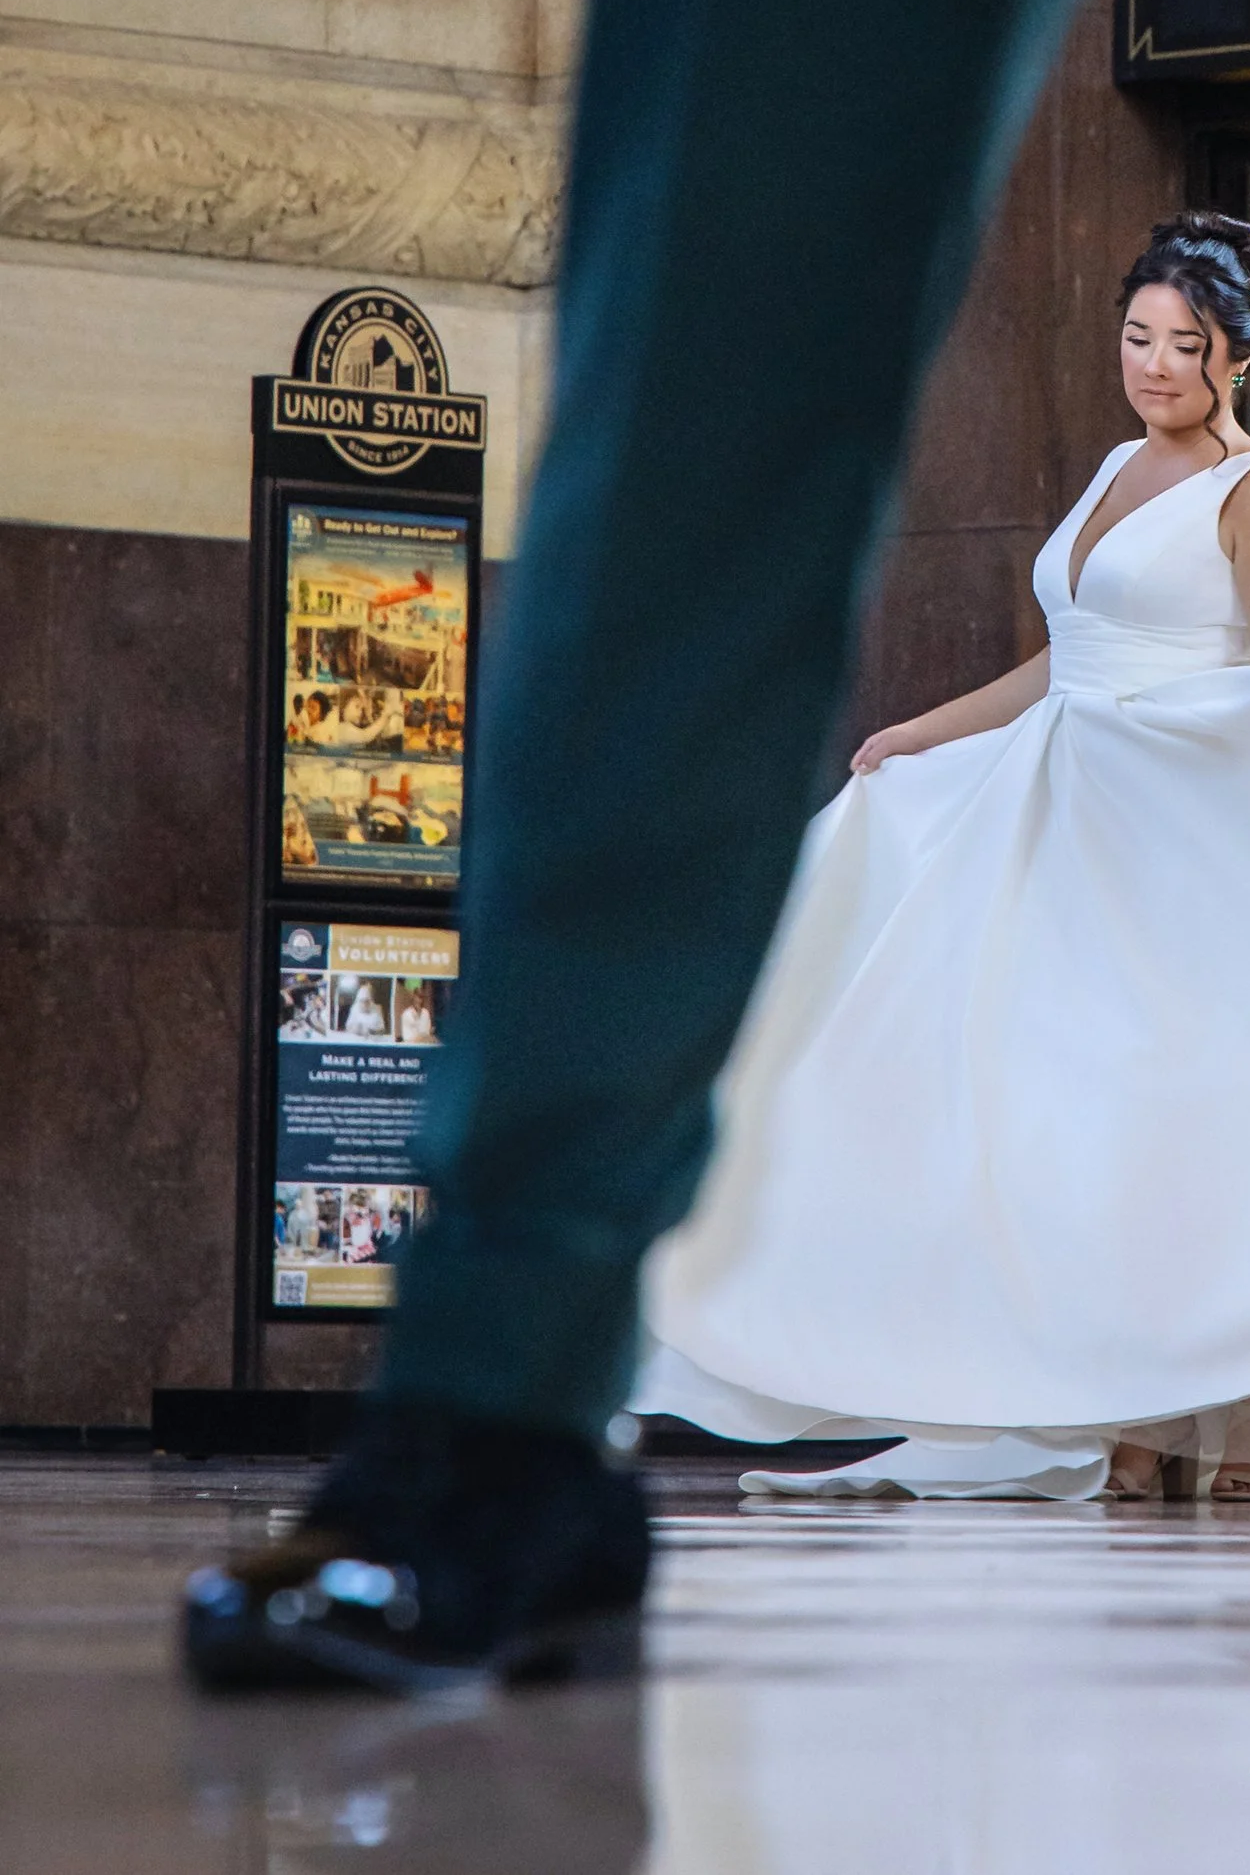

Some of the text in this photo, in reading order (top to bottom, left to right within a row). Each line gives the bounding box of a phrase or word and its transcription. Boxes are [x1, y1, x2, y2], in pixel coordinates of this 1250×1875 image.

[320, 300, 439, 382] KANSAS CITY
[284, 392, 477, 436] UNION STATION
[348, 440, 383, 464] SINCE
[337, 946, 450, 965] VOLUNTEERS
[308, 1070, 358, 1083] LASTING
